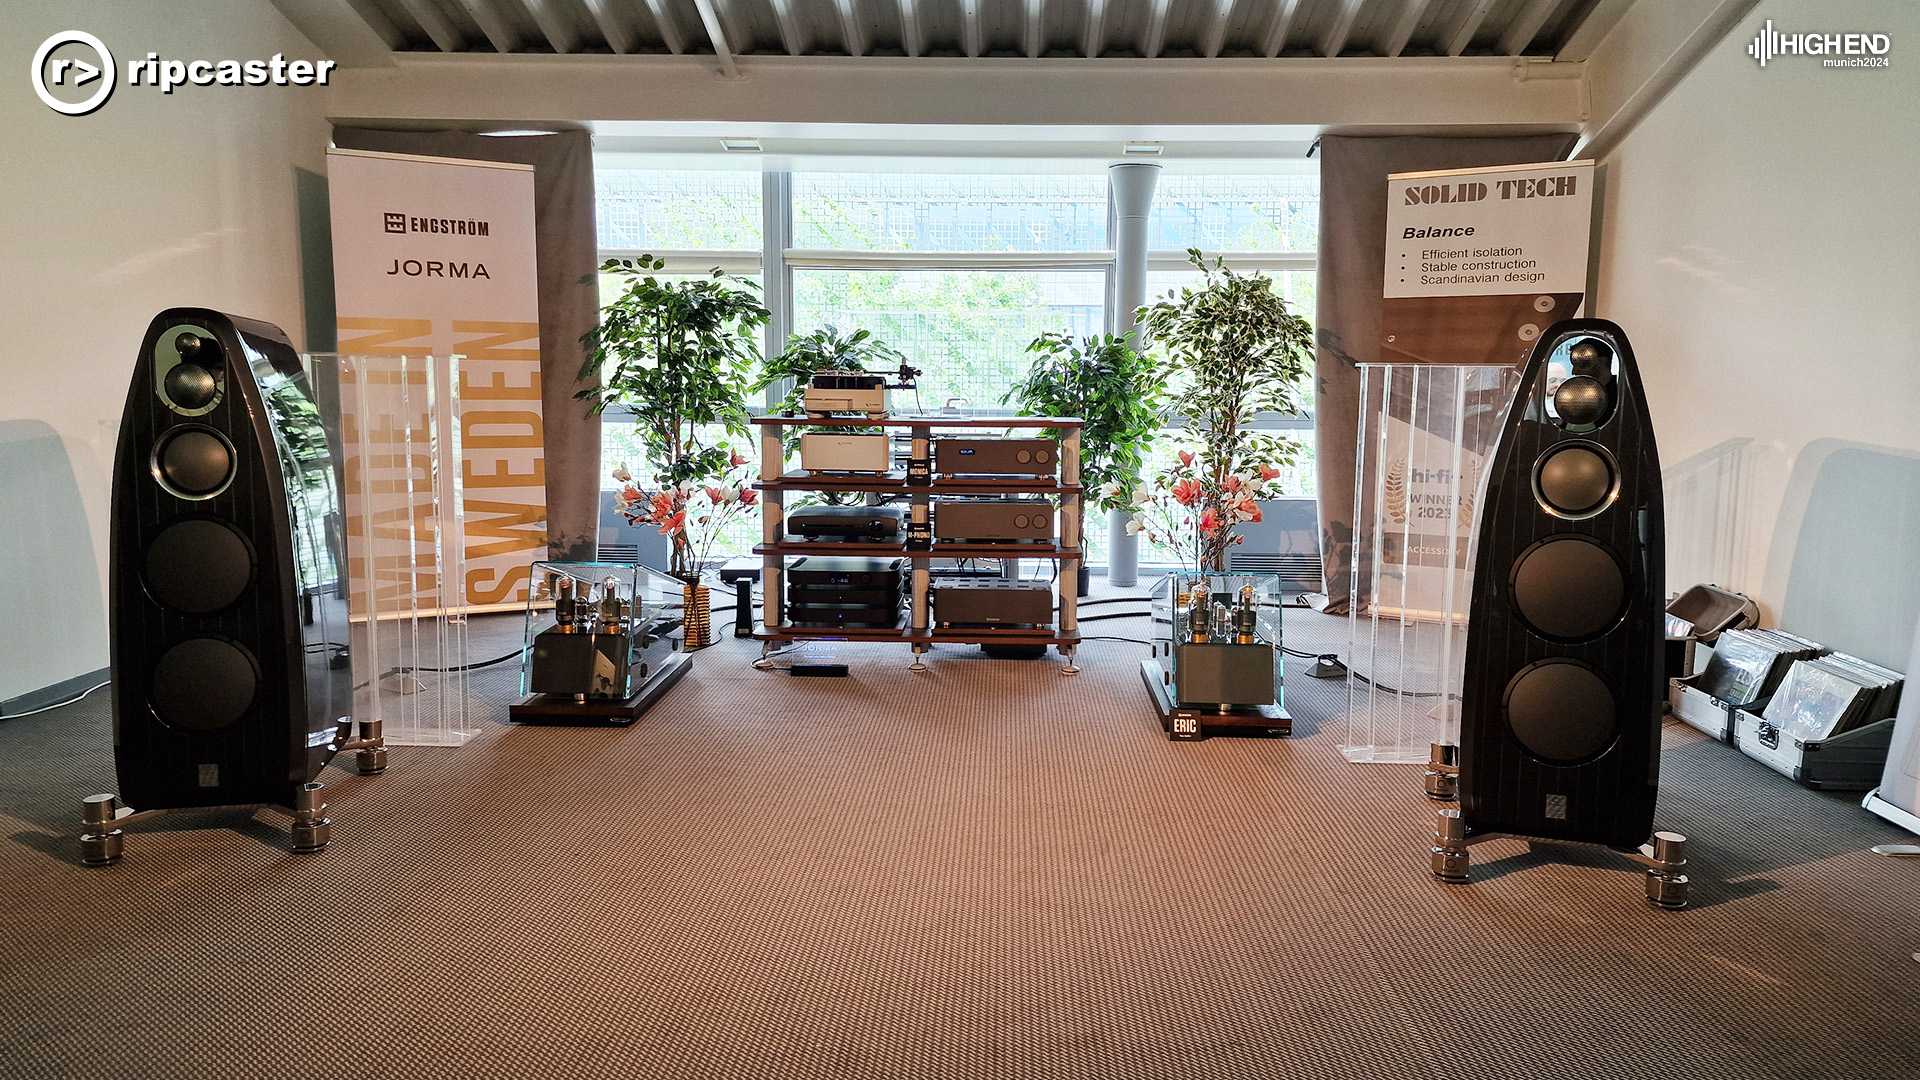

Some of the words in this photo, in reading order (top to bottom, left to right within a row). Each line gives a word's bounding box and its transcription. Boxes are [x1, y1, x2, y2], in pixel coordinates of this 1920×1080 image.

[1404, 182, 1488, 206] SOLID
[1496, 175, 1577, 200] TECH
[410, 217, 489, 236] ENGSTRÖM
[1402, 226, 1475, 240] Balance
[1421, 249, 1468, 260] Efficient
[1472, 246, 1523, 257] isolation
[386, 259, 491, 280] JORMA
[1421, 262, 1457, 273] Stable
[1461, 259, 1536, 271] construction
[1420, 274, 1500, 285] Scandinavian
[1504, 272, 1545, 284] design
[337, 316, 433, 385] IN
[452, 319, 549, 606] SWEDEN
[1411, 468, 1463, 484] hi-fi
[340, 412, 438, 614] MADE
[1407, 546, 1461, 555] ACCESSOY
[1173, 718, 1197, 734] ERIC
